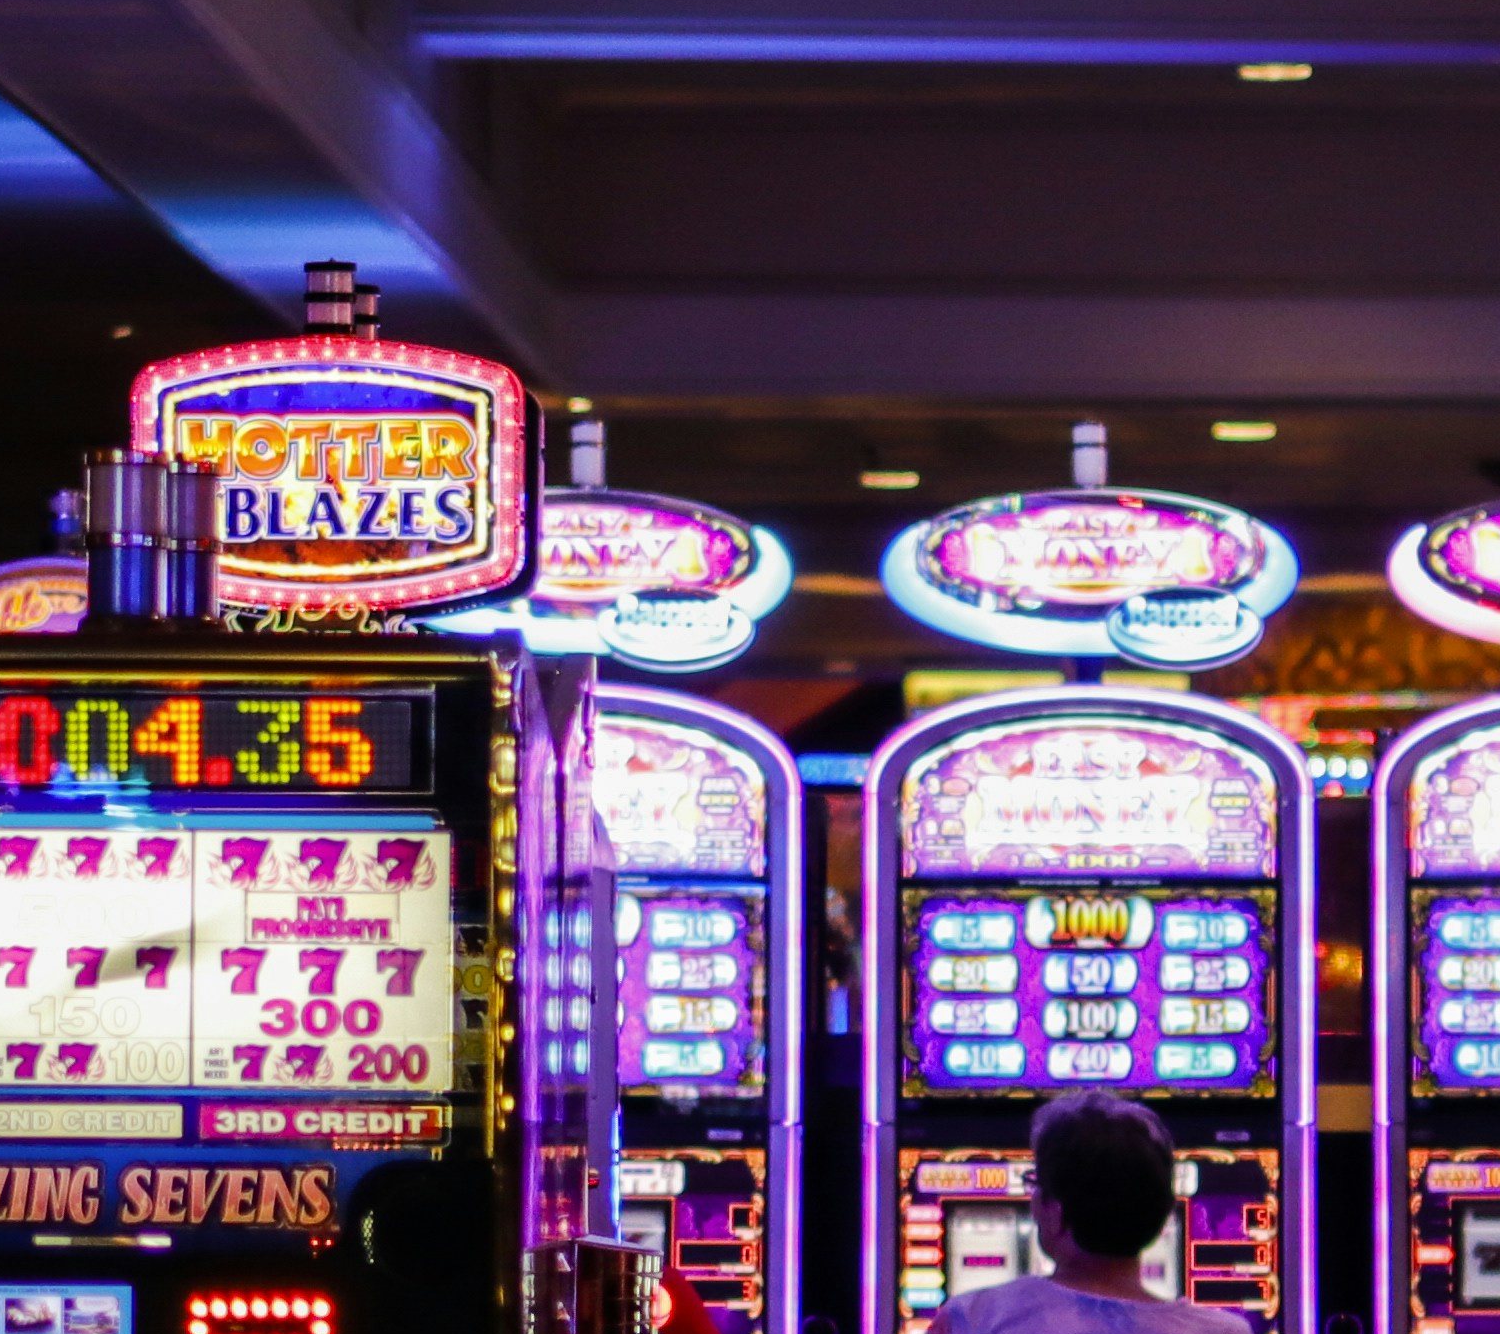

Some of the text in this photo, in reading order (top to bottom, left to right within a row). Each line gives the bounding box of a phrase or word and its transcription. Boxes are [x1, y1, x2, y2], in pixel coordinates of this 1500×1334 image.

[180, 417, 479, 482] HOTTER
[224, 485, 475, 543] BLAZES
[538, 531, 676, 579] ONEY
[1051, 899, 1130, 941] 1000
[376, 947, 427, 997] 7
[1072, 956, 1111, 986] 50
[28, 994, 142, 1037] 150
[259, 997, 384, 1039] 300
[1066, 1001, 1117, 1031] 100
[109, 1041, 185, 1083] 100
[347, 1043, 431, 1084] 200
[1072, 1042, 1110, 1072] 40
[61, 1110, 177, 1134] CREDIT
[213, 1110, 429, 1136] 3RD CREDIT
[120, 1166, 337, 1227] SEVENS
